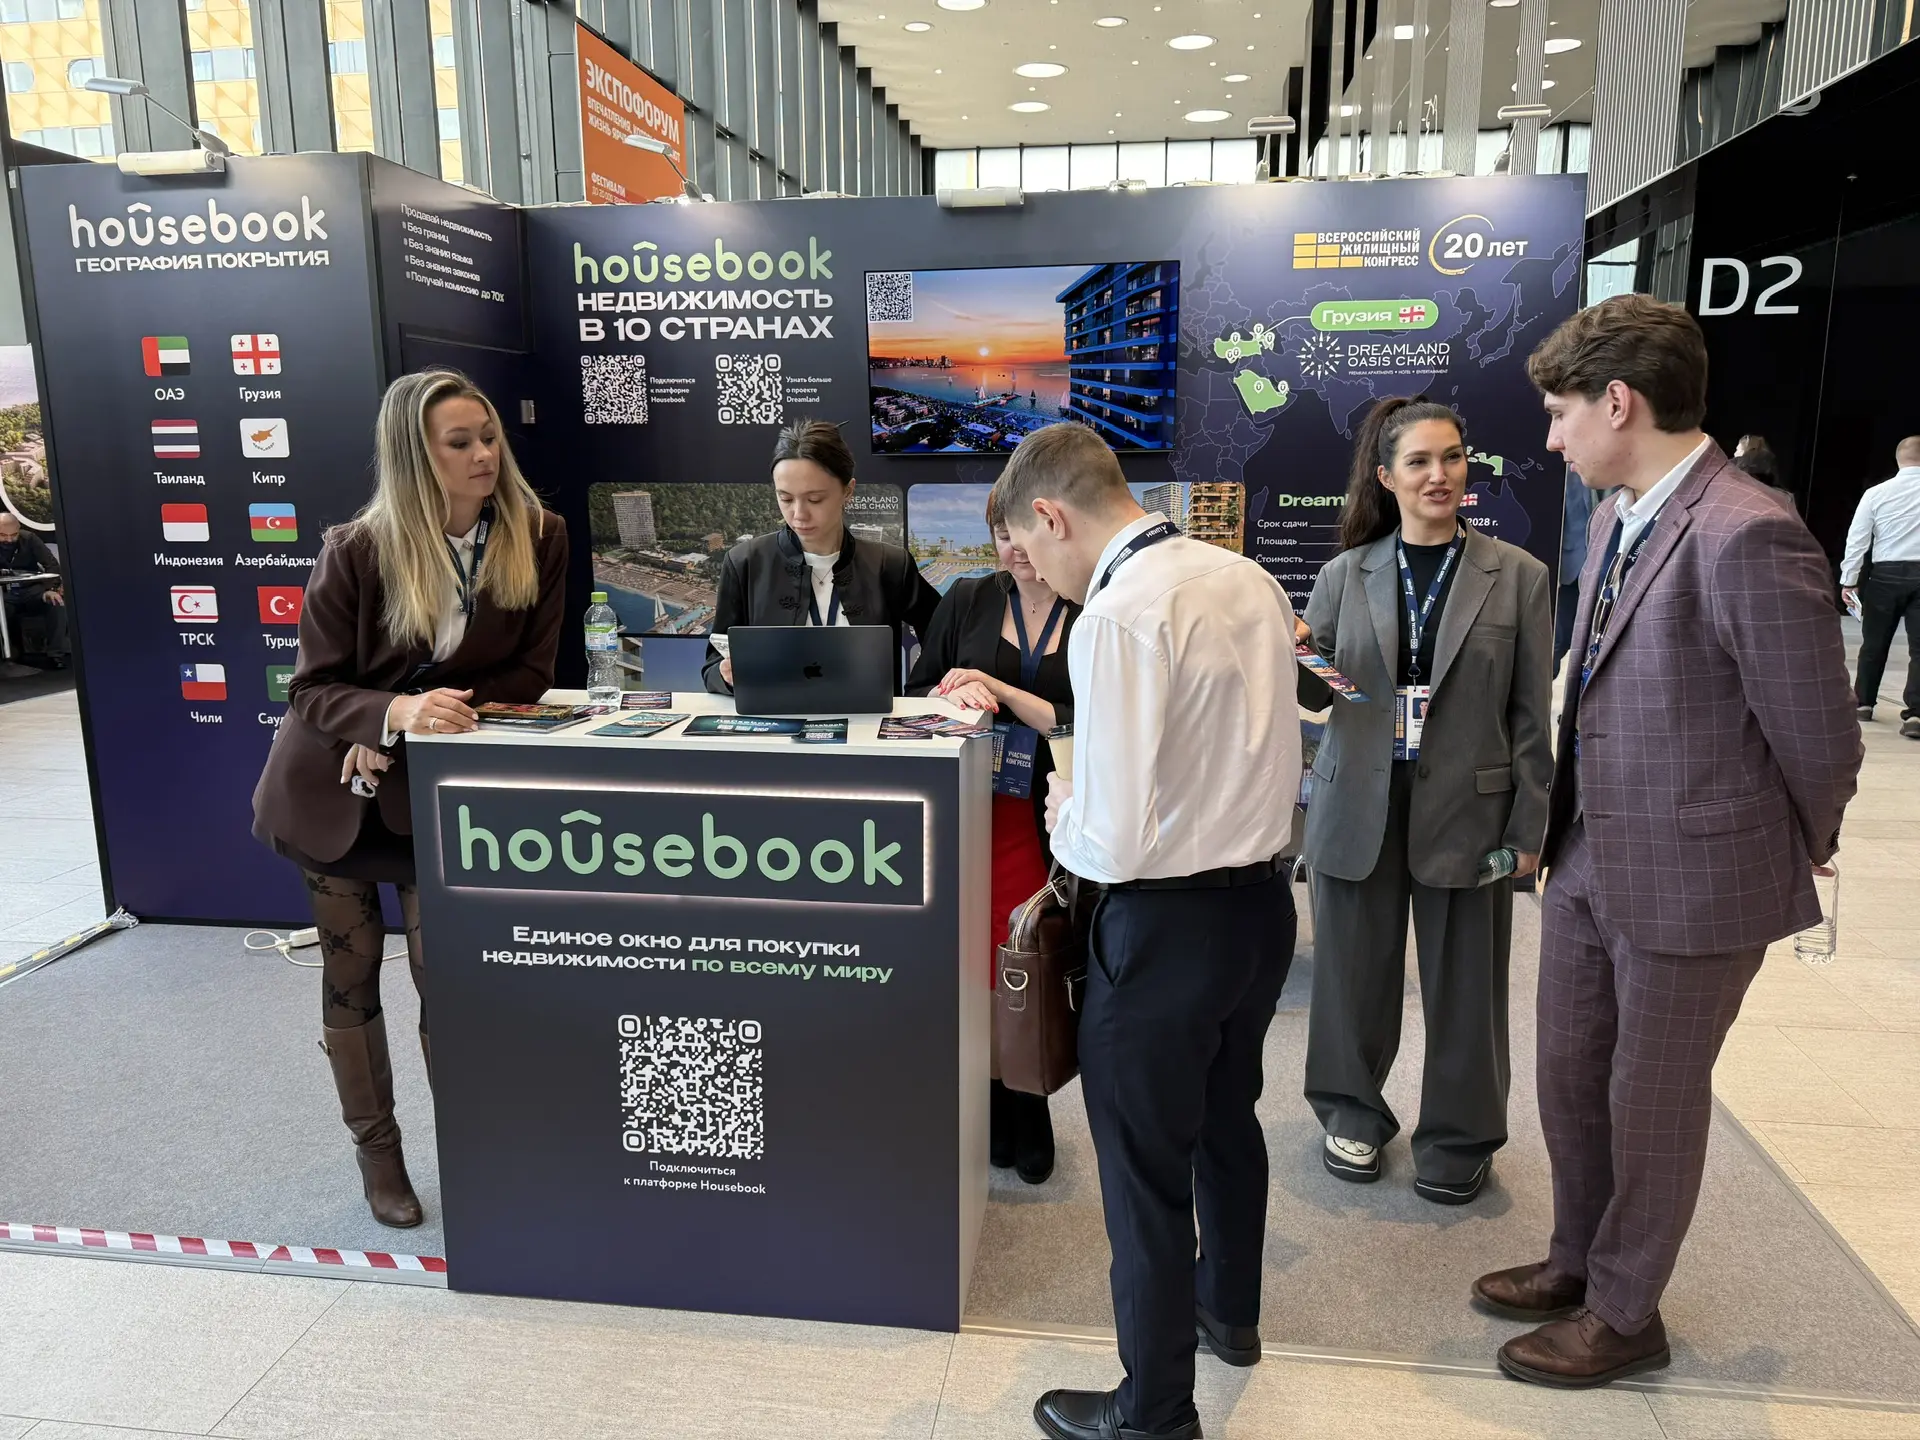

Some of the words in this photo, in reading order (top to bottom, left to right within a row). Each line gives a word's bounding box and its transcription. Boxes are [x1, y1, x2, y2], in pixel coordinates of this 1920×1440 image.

[585, 57, 680, 145] ЭКСПОФОРУМ
[588, 112, 611, 137] ЖИЗНЬ
[591, 171, 626, 199] ФЕСТИВАЛИ
[400, 203, 440, 225] Продавай
[440, 218, 493, 242] недвижимость
[407, 221, 422, 235] Без
[423, 228, 450, 244] границ
[1317, 227, 1421, 244] ВСЕРОССИЙСКИЙ
[408, 238, 424, 251] Без
[424, 243, 451, 259] знания
[451, 252, 474, 265] языка
[1341, 239, 1420, 256] ЖИЛИЩНЫЙ
[1443, 232, 1484, 259] 20
[1487, 241, 1528, 257] лет
[75, 254, 203, 273] ГЕОГРАФИЯ
[207, 250, 330, 269] ПОКРЫТИЯ
[409, 255, 425, 268] Без
[425, 260, 452, 275] знания
[452, 268, 480, 282] законов
[1364, 255, 1419, 268] КОНГРЕСС
[411, 271, 444, 288] Получай
[445, 281, 480, 296] комиссию
[481, 290, 491, 300] до
[1698, 255, 1803, 316] D2
[577, 289, 833, 313] НЕДВИЖИМОСТЬ
[1321, 309, 1392, 326] Грузия
[579, 318, 606, 342] В
[613, 317, 651, 342] 10
[659, 315, 834, 341] СТРАНАХ
[1347, 343, 1450, 356] DREAMLAND
[1347, 356, 1391, 367] OASIS
[1395, 355, 1450, 366] CHAKVI
[650, 376, 696, 385] Подключиться
[786, 376, 807, 384] Узнать
[154, 387, 185, 401] ОАЭ
[239, 387, 281, 402] Грузия
[656, 387, 690, 395] платформе
[153, 472, 205, 486] Таиланд
[252, 471, 286, 486] Кипр
[851, 496, 899, 504] REAMLAND
[1257, 519, 1280, 529] Срок
[1282, 521, 1308, 529] сдачи
[1467, 517, 1490, 527] 2028
[1256, 537, 1297, 546] Площадь
[154, 553, 223, 569] Индонезия
[1255, 554, 1303, 563] Стоимость
[1272, 573, 1308, 581] ичество
[179, 633, 216, 646] ТРСК
[262, 634, 300, 649] Турци
[190, 711, 222, 724] Чили
[1006, 757, 1031, 768] КОНГРЕССА
[1007, 751, 1032, 761] УЧАСТНИК
[512, 926, 613, 947] Единое
[619, 933, 682, 949] окно
[688, 936, 741, 952] для
[747, 939, 860, 958] покупки
[482, 950, 686, 971] недвижимости
[692, 959, 724, 973] по
[730, 961, 816, 980] всему
[823, 964, 893, 984] миру
[649, 1160, 736, 1176] Подключиться
[624, 1177, 631, 1185] к
[633, 1177, 698, 1190] платформе
[700, 1180, 766, 1194] Housebook
